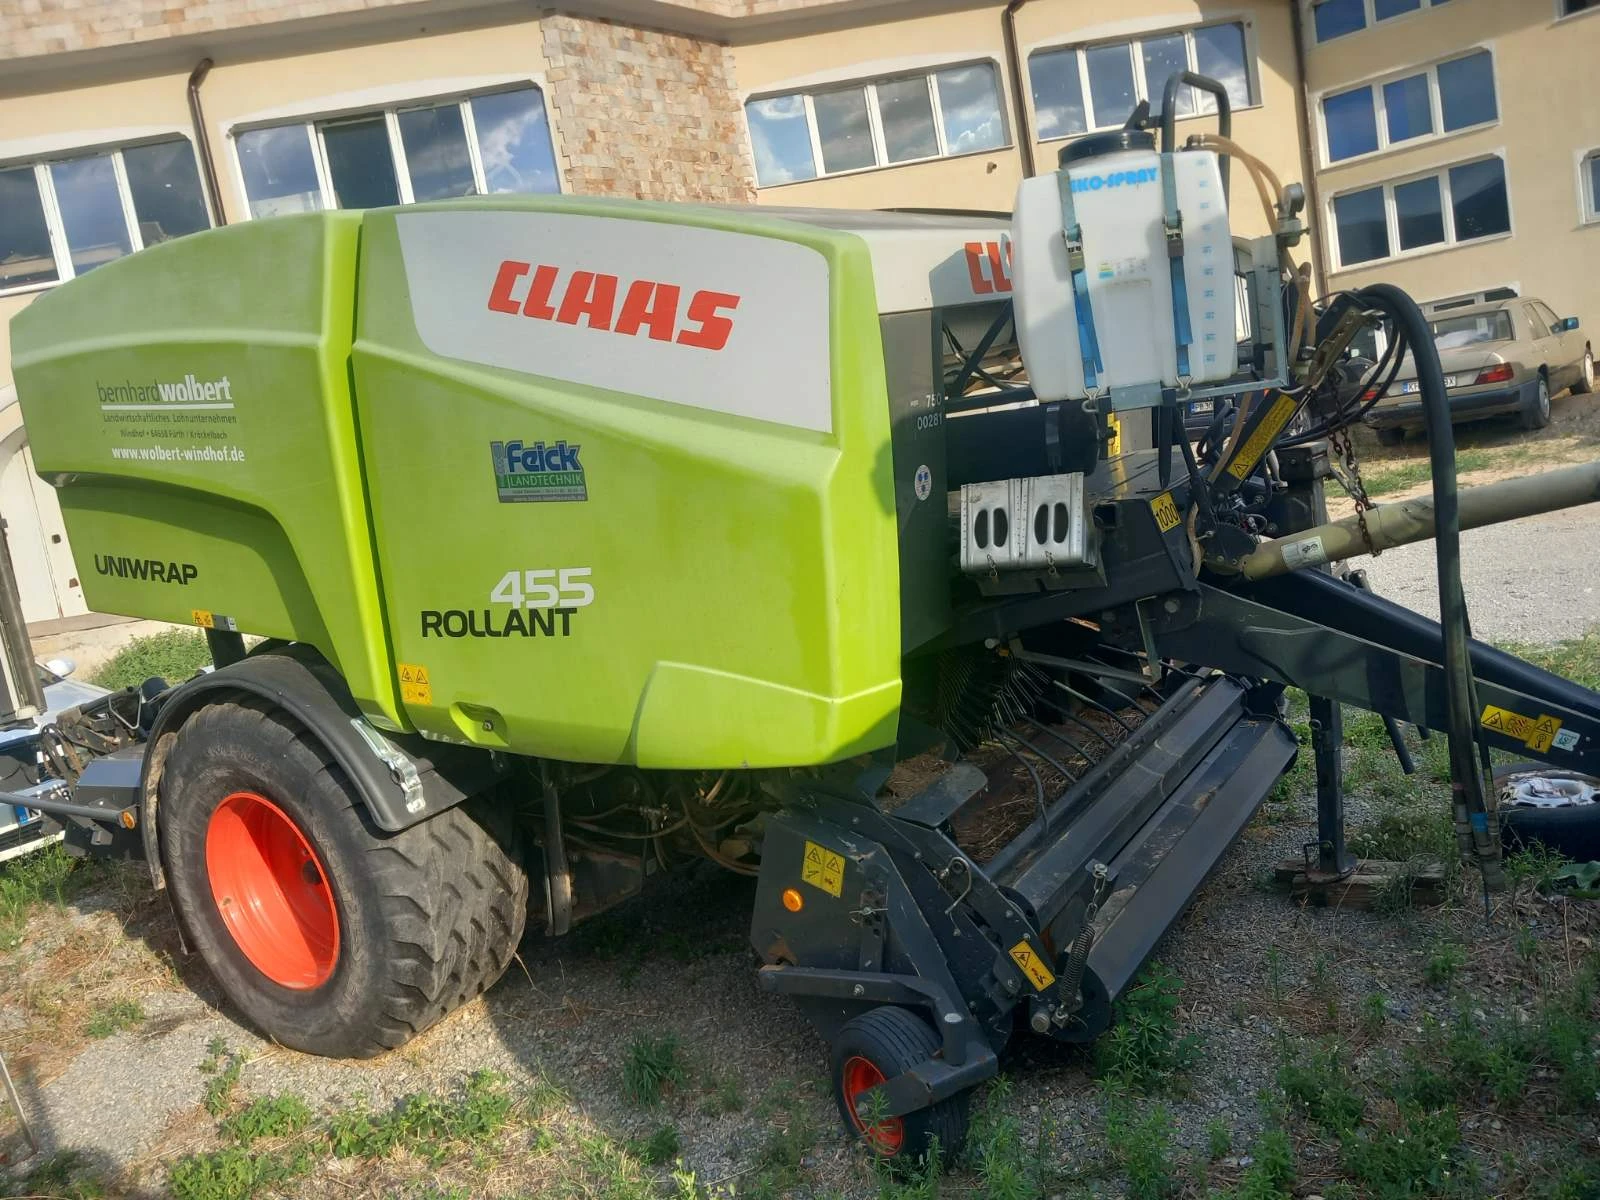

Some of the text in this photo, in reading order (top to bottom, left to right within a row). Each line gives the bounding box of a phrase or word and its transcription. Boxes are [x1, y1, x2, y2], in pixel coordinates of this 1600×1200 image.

[964, 242, 1012, 294] CL
[488, 260, 740, 350] CLAAS
[103, 413, 237, 424] Landwirtschaftliches Lohnunternehmen
[112, 444, 245, 462] www.wolbert-windhof.de
[505, 440, 581, 473] Feick
[510, 473, 584, 487] LANDTECHNIK
[94, 553, 198, 585] UNIWRAP
[491, 567, 595, 609] 455
[421, 607, 578, 638] ROLLANT
